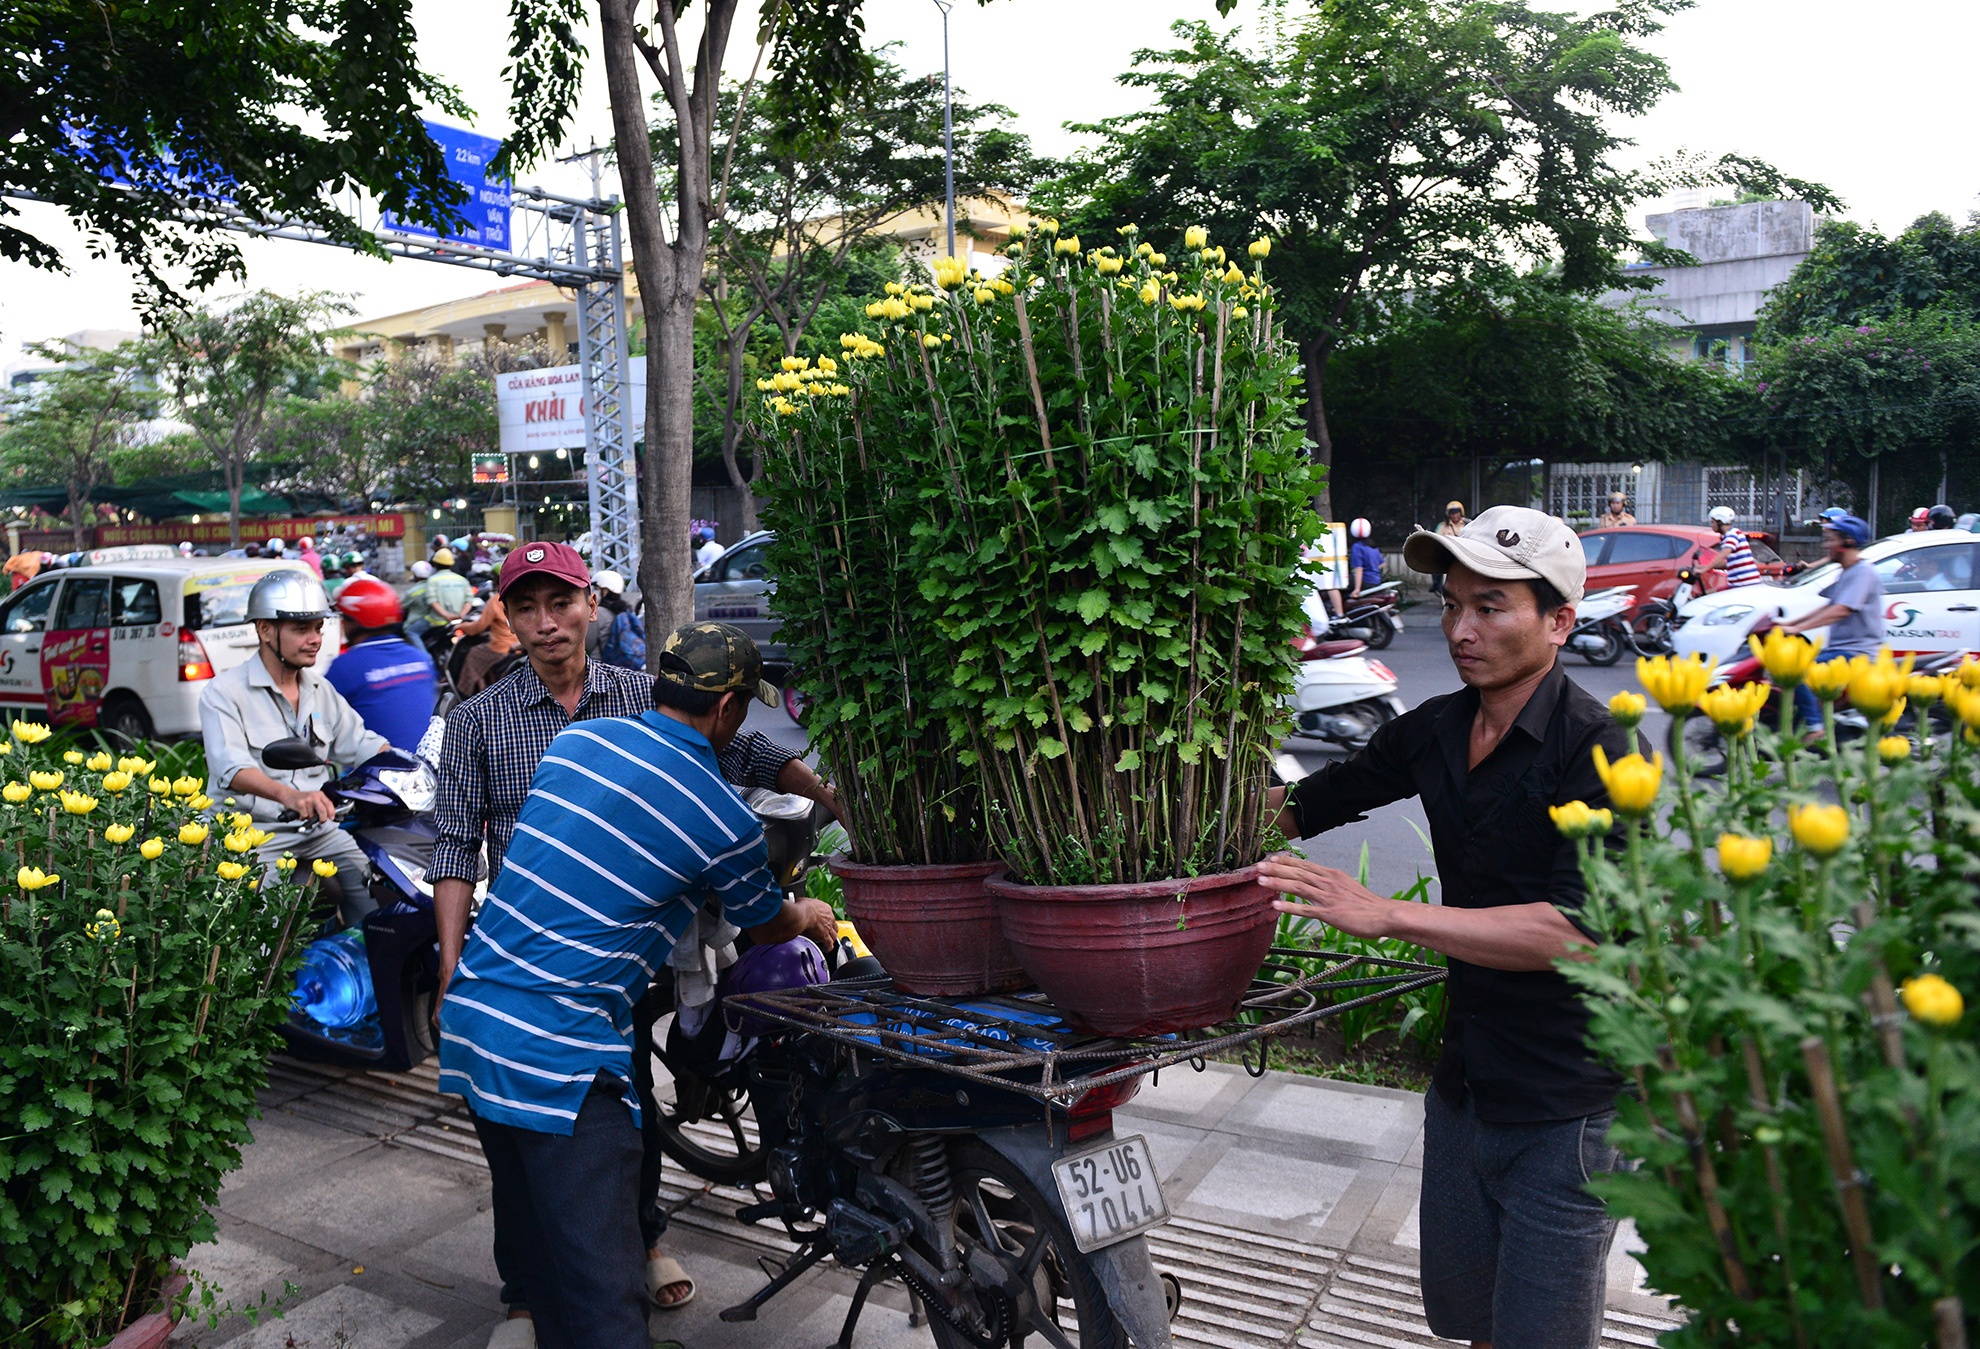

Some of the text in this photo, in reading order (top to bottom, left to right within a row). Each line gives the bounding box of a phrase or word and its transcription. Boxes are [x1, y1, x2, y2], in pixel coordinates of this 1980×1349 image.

[525, 391, 566, 423] KHẢI
[202, 630, 248, 642] VINASUN
[368, 924, 395, 934] HONDA
[1081, 1185, 1156, 1240] 7044
